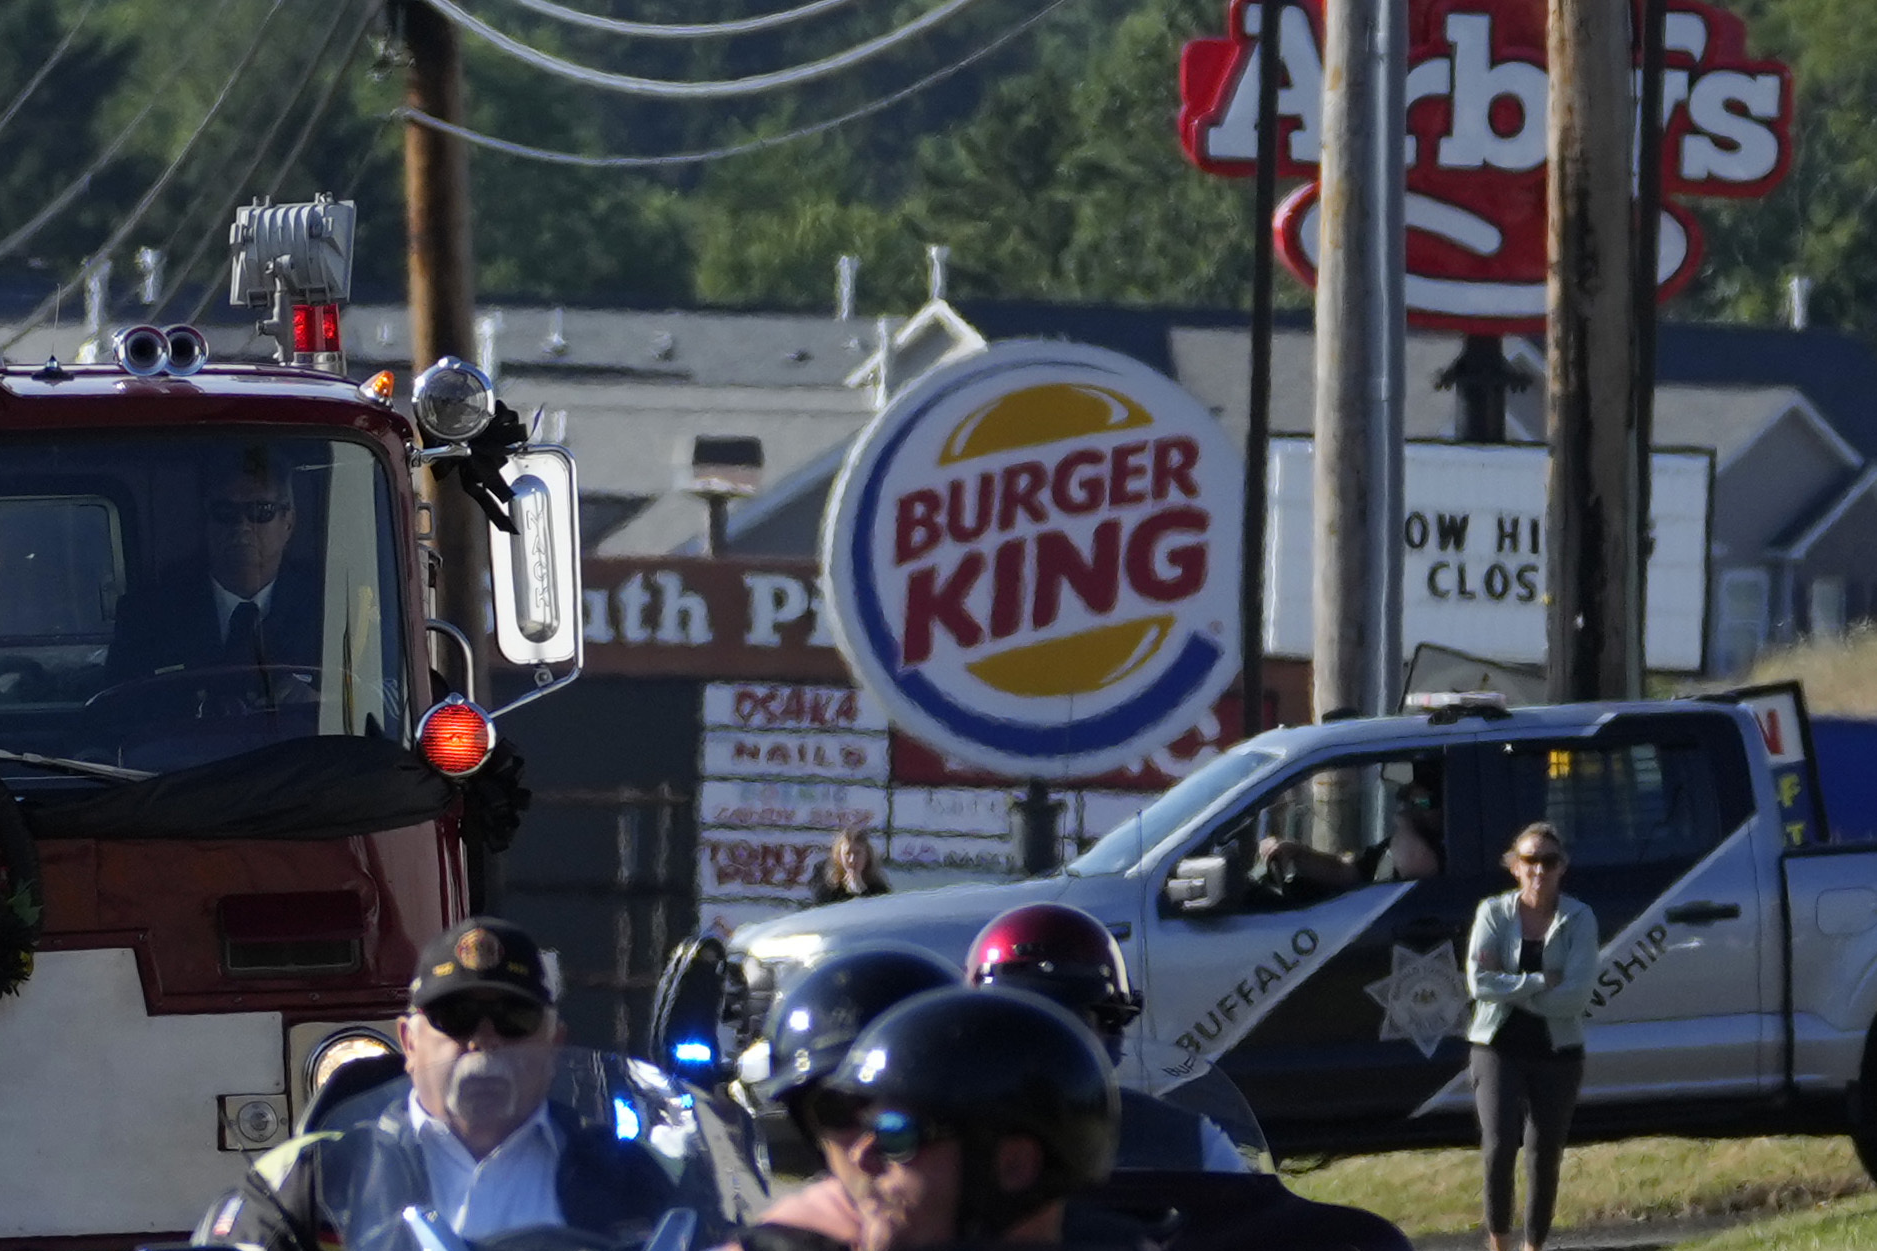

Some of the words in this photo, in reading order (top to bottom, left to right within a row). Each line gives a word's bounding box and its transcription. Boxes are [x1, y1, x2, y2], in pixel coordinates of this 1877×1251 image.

[1208, 3, 1781, 182] Arb's
[895, 434, 1201, 567] BURGER
[1404, 510, 1470, 552] OW
[902, 504, 1211, 669] KING
[1427, 560, 1540, 602] CLOS
[1175, 927, 1320, 1054] BUFFALO
[1580, 924, 1669, 1020] NSHIP
